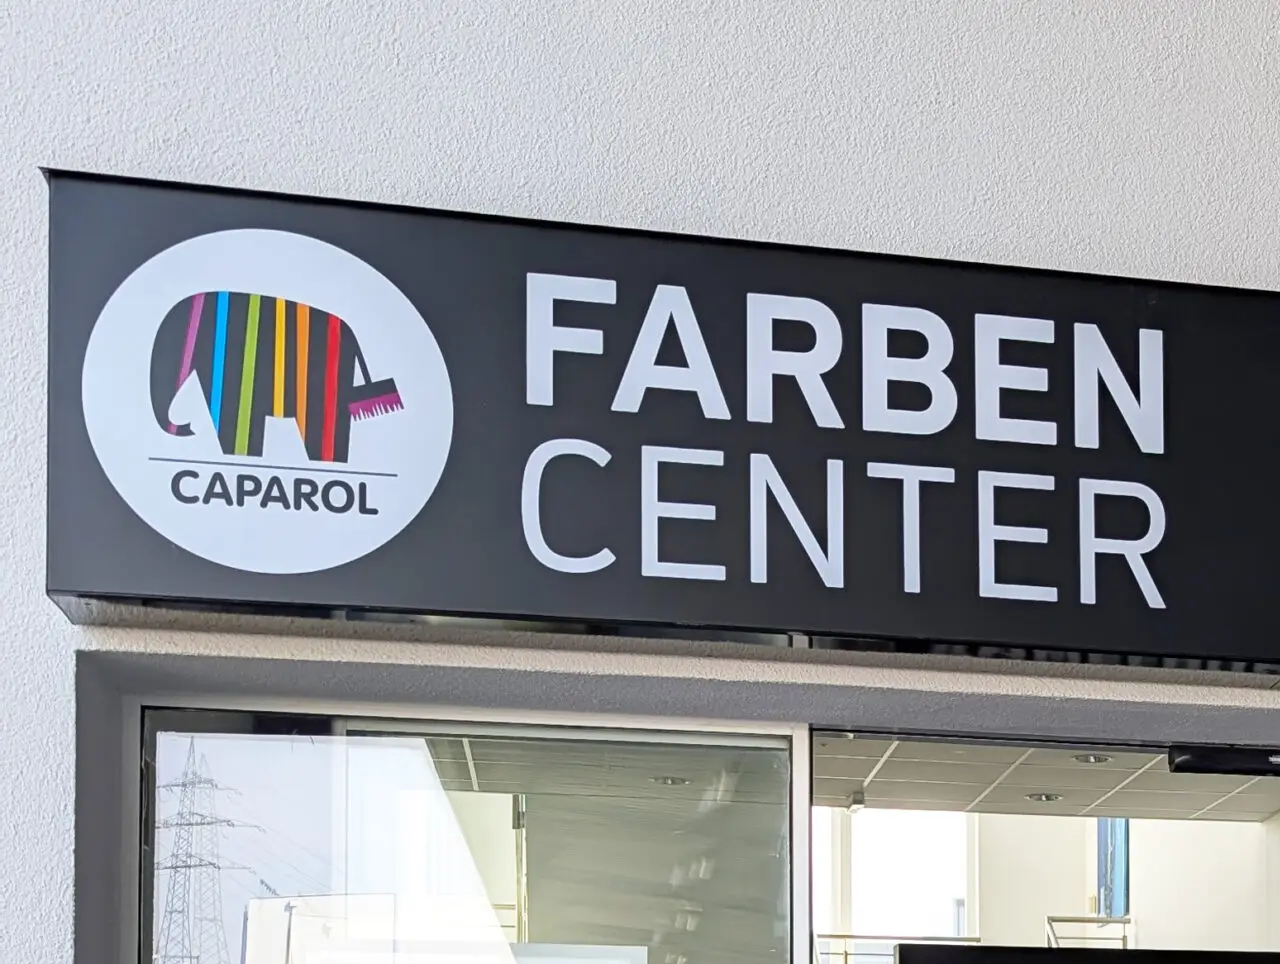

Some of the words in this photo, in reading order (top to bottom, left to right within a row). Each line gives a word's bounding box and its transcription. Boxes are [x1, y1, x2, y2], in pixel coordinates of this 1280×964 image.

[526, 272, 1165, 454] FARBEN
[171, 469, 378, 515] CAPAROL
[521, 438, 1167, 609] CENTER
